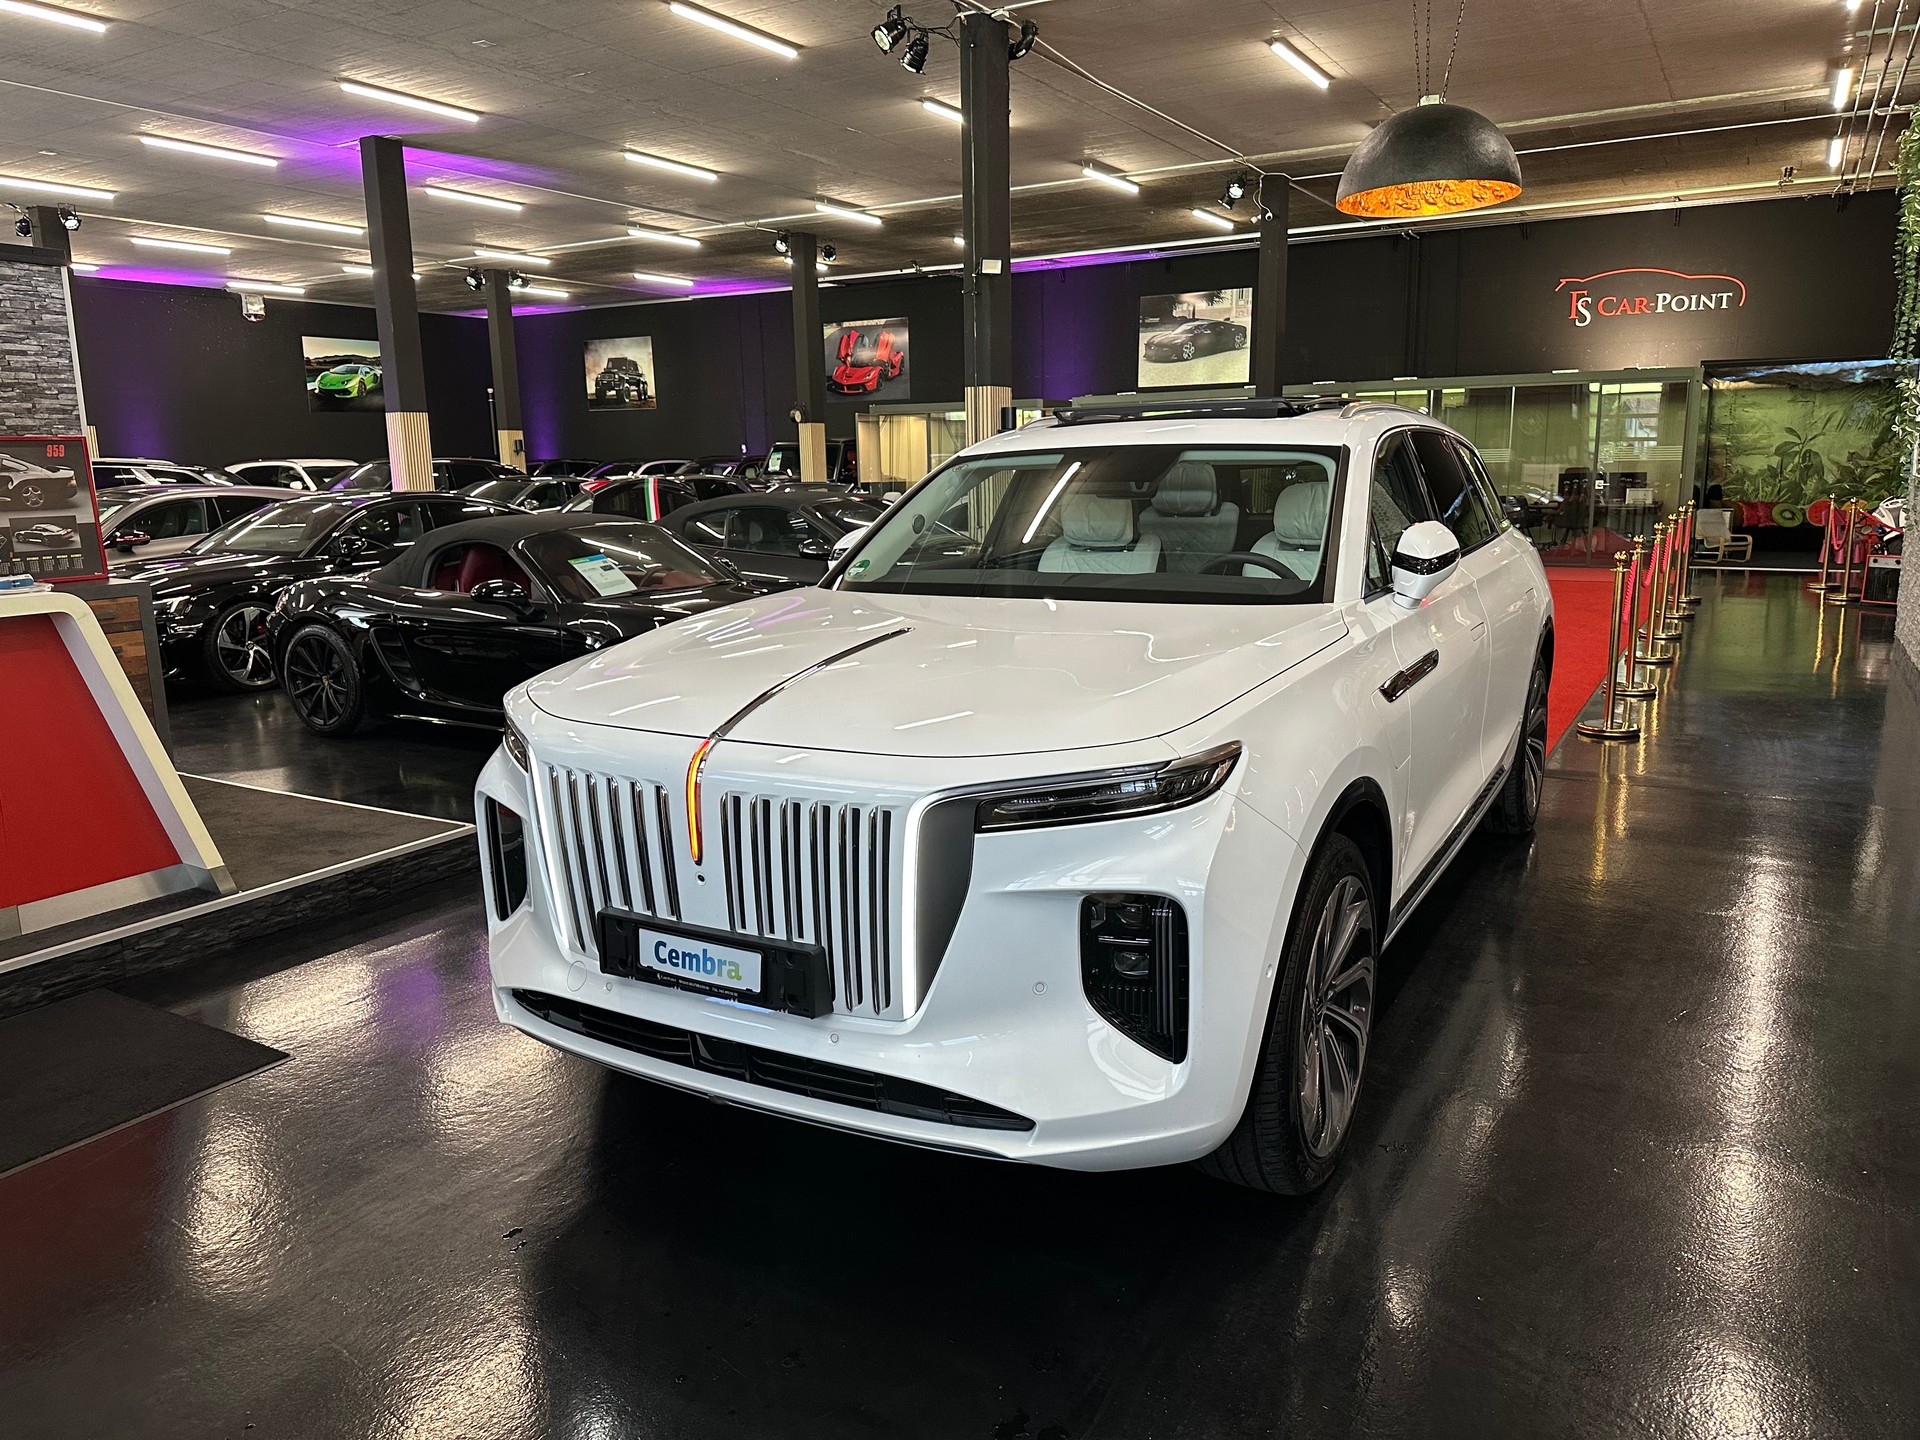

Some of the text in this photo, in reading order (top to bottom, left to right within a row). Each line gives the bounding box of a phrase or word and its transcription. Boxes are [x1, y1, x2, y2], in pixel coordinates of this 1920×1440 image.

[1568, 290, 1592, 327] FS
[46, 444, 65, 458] 959
[653, 940, 743, 981] Cembra
